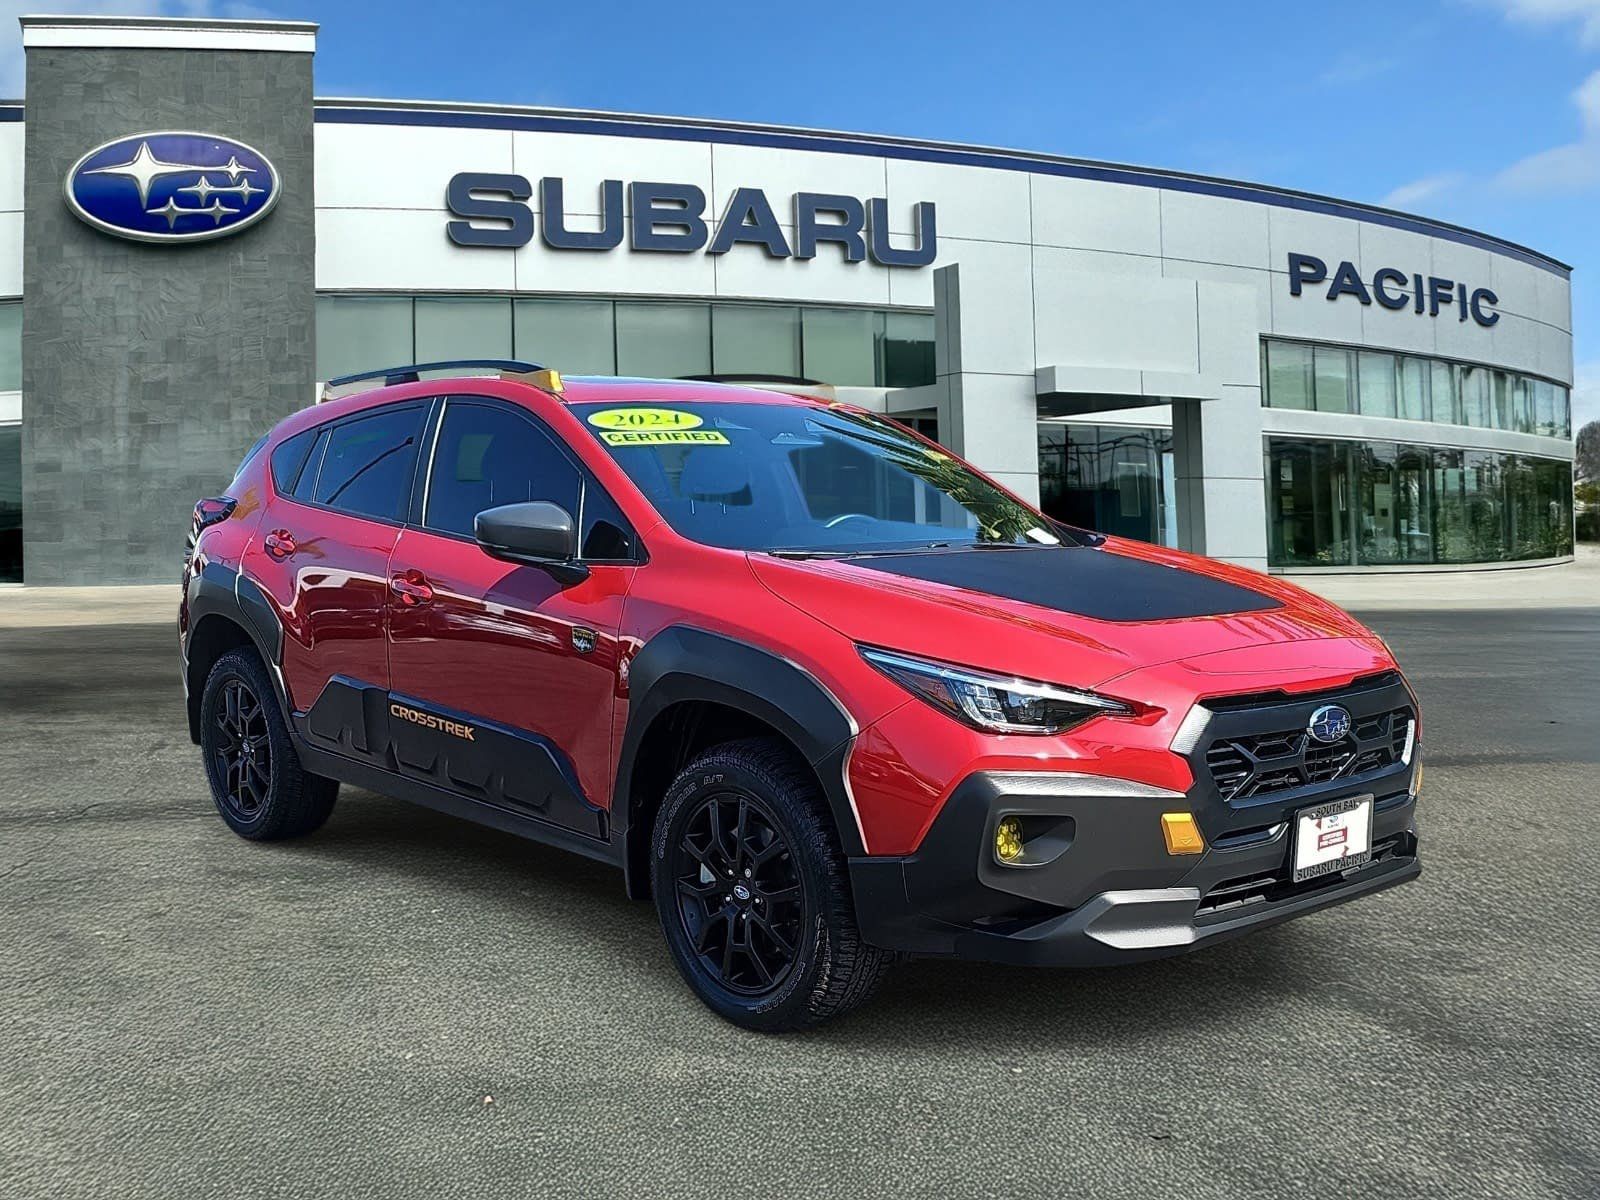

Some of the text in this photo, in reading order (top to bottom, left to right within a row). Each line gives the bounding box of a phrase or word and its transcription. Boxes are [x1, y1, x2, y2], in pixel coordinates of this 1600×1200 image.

[446, 172, 937, 267] SUBARU
[1288, 252, 1500, 327] PACIFIC
[613, 413, 680, 427] 2024
[606, 432, 720, 443] CERTIFIED
[390, 704, 475, 741] CROSSTREK
[1315, 803, 1342, 816] SOUTH
[1297, 851, 1370, 880] SUBARU PACIFIC
